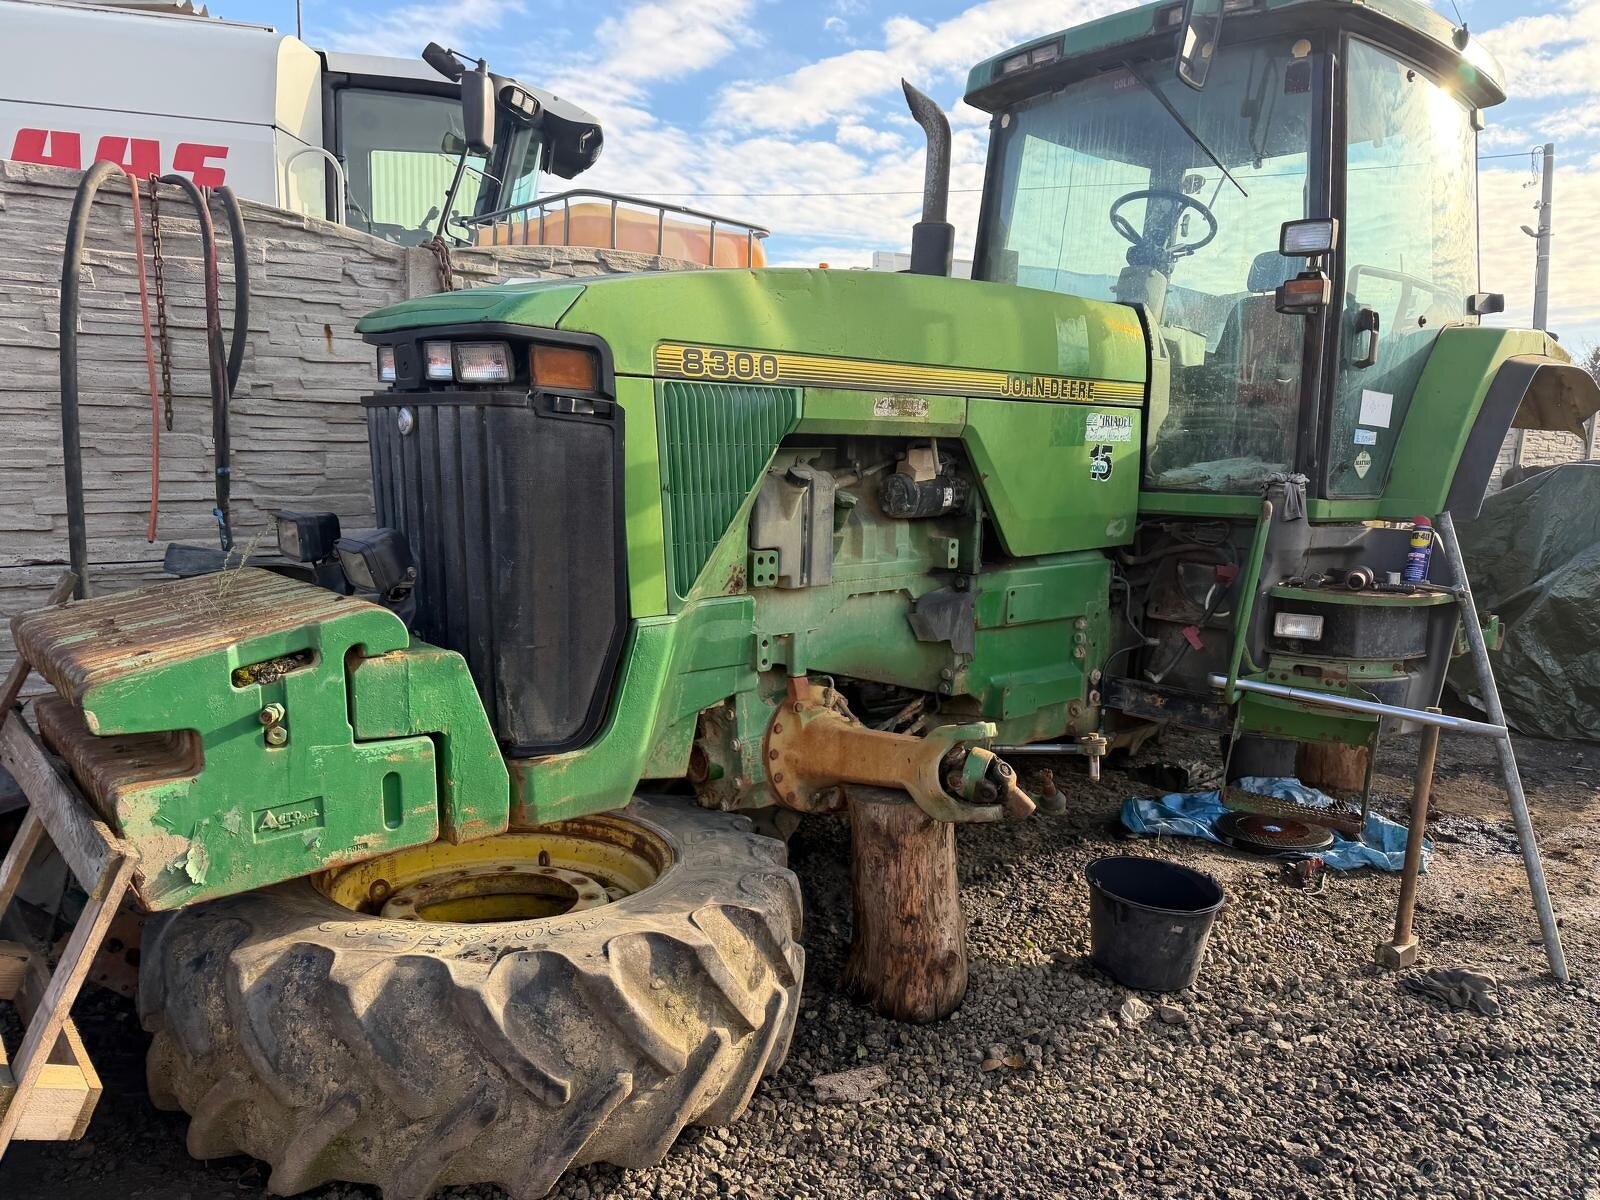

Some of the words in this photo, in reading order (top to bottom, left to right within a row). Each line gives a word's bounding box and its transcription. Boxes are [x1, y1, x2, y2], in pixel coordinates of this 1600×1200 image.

[682, 349, 778, 380] 8300
[1001, 376, 1045, 397] JOHN
[1050, 379, 1095, 401] DEERE
